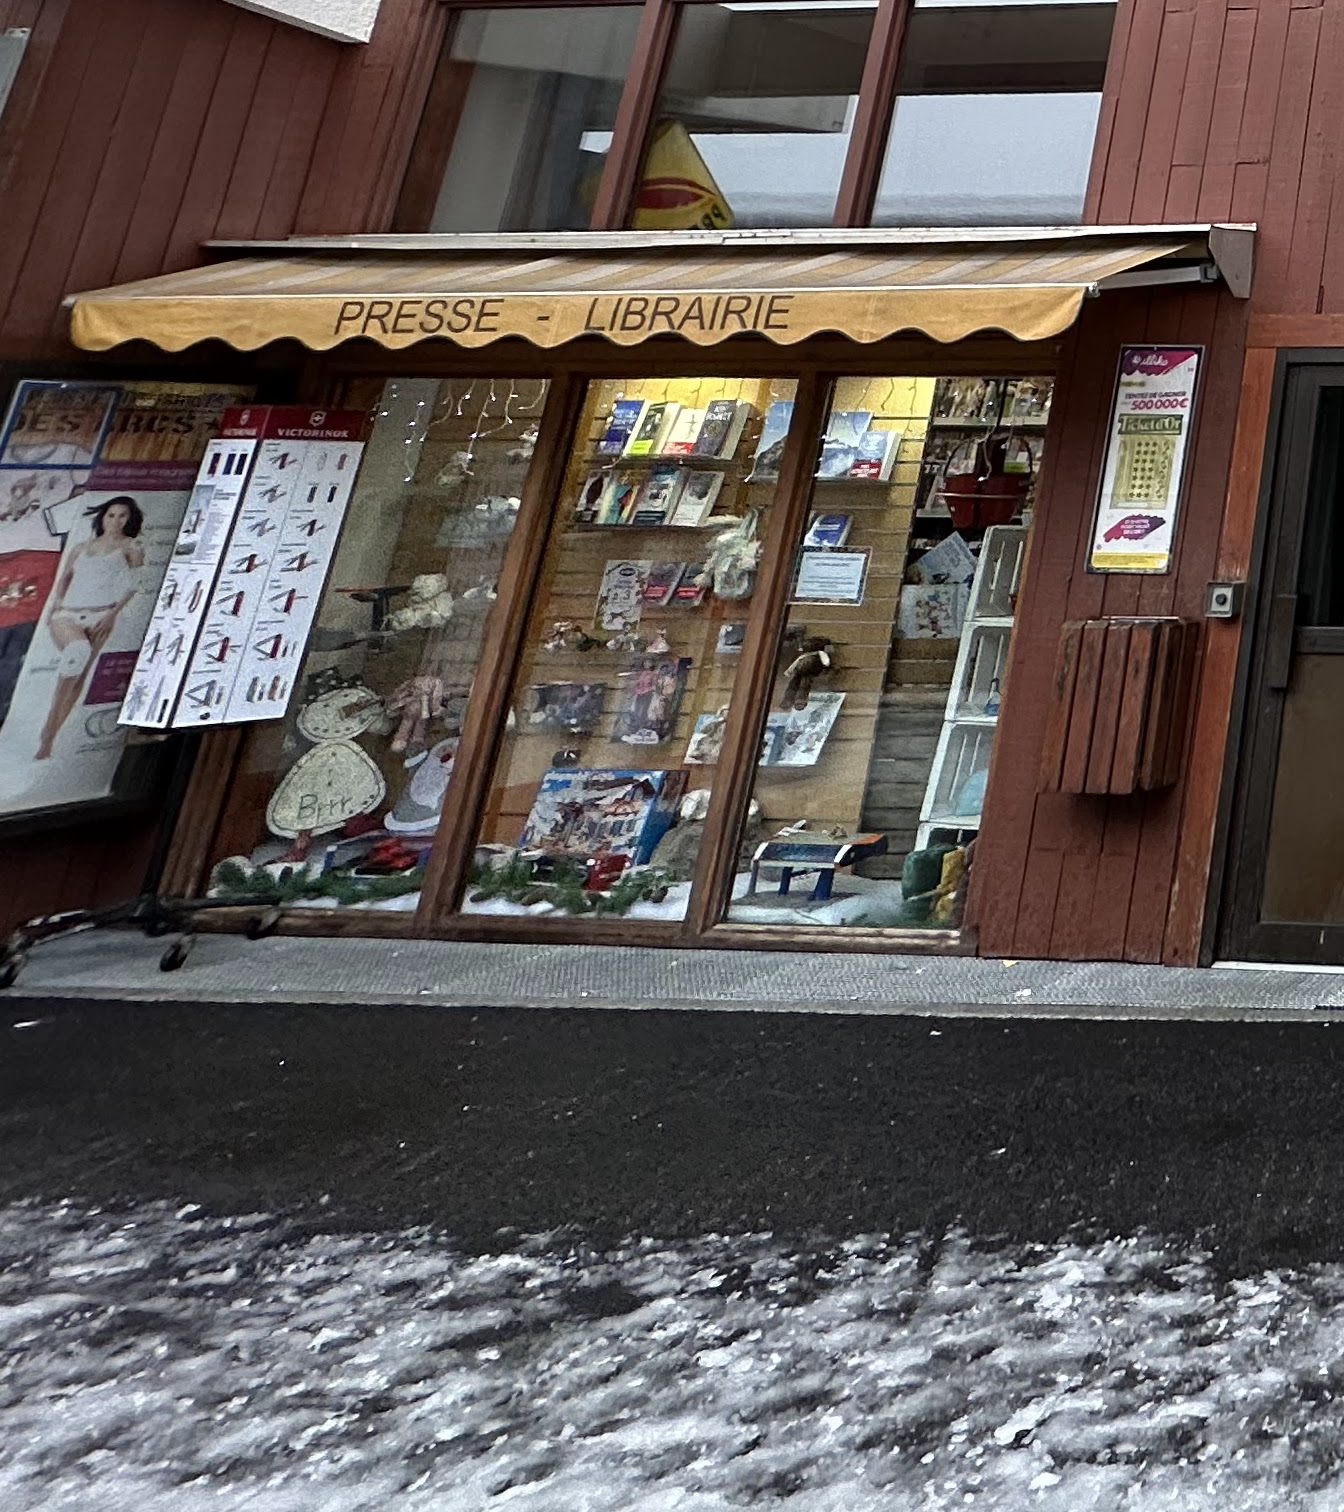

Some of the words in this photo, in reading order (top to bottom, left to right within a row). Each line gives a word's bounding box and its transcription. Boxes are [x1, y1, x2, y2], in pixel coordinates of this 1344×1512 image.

[334, 297, 504, 335] PRESSE
[584, 294, 796, 332] LIBRAIRIE
[277, 427, 349, 438] VICTORINOX
